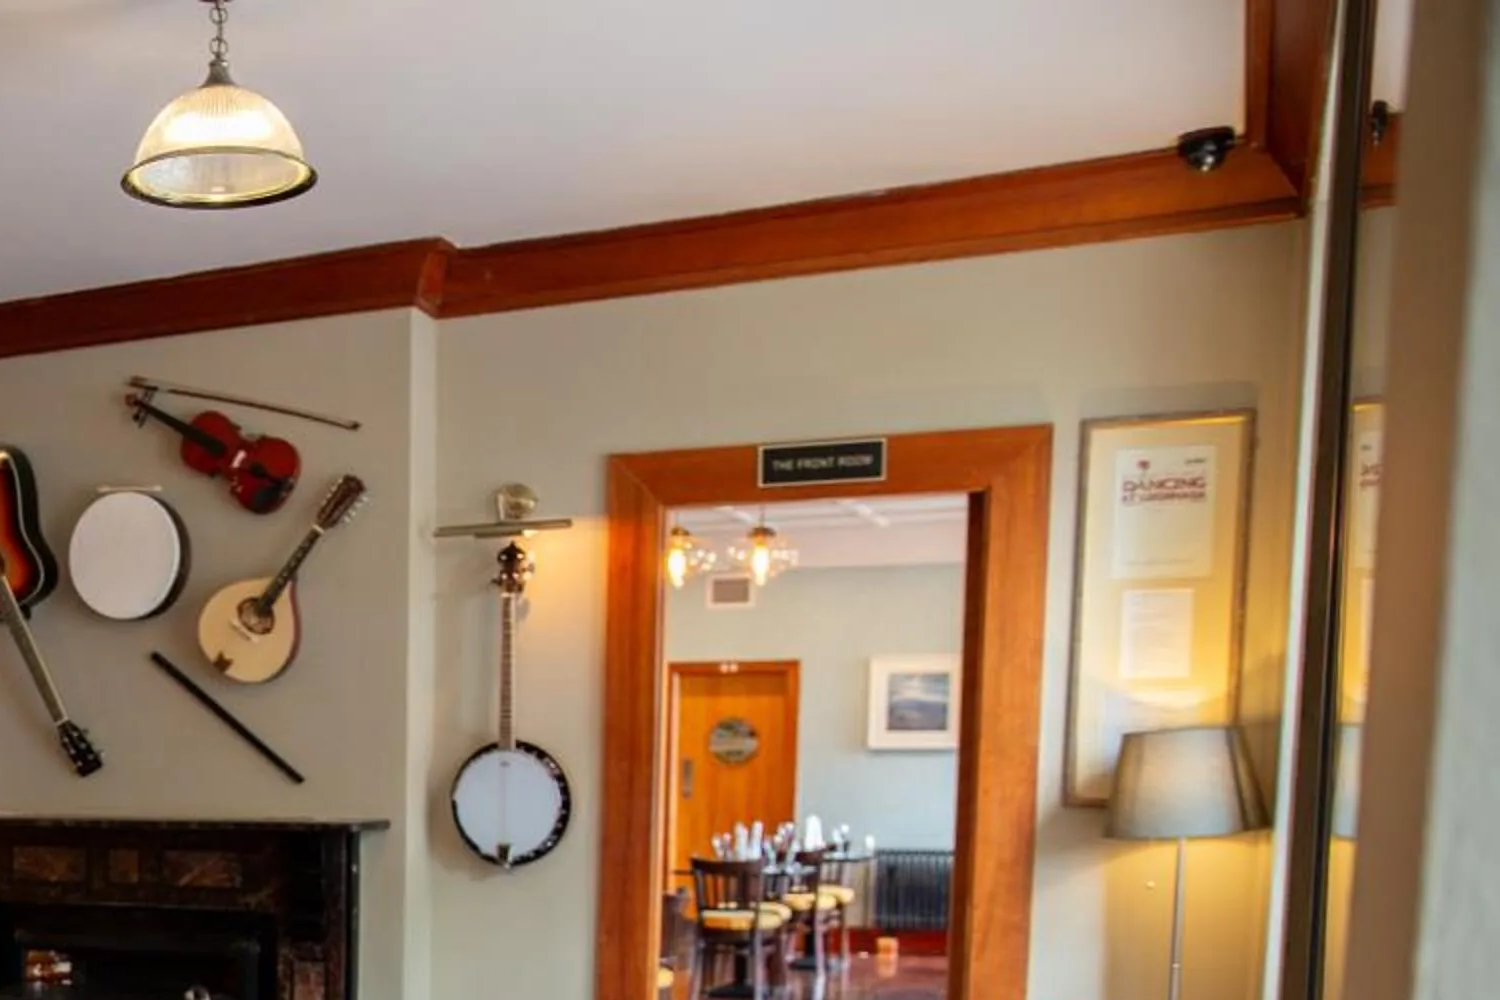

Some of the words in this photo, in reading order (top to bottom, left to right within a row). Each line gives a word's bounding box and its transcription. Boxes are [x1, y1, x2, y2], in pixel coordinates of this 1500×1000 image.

[772, 459, 794, 471] THE
[797, 456, 835, 469] FRONT
[837, 454, 874, 467] ROOM
